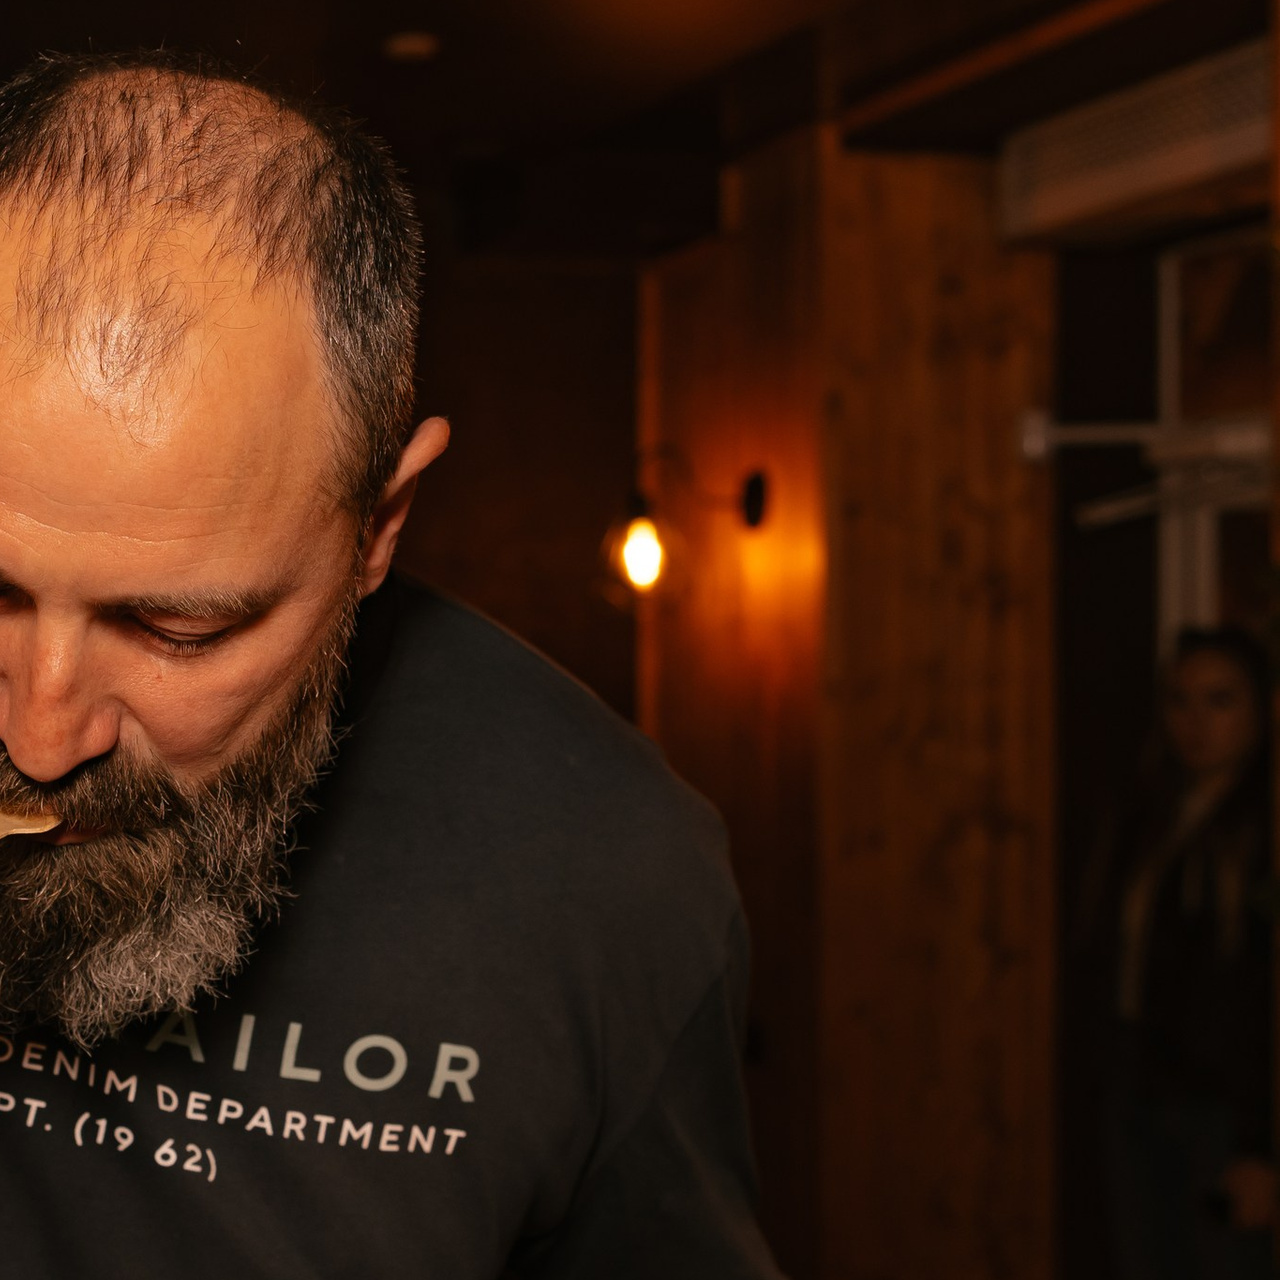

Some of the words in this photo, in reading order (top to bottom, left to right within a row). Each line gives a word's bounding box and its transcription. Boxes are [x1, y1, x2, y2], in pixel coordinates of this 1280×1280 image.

[144, 1004, 481, 1104] AILOR
[73, 1111, 136, 1153] (19
[153, 1137, 218, 1183] 62)
[156, 1083, 468, 1156] DEPARTMENT
